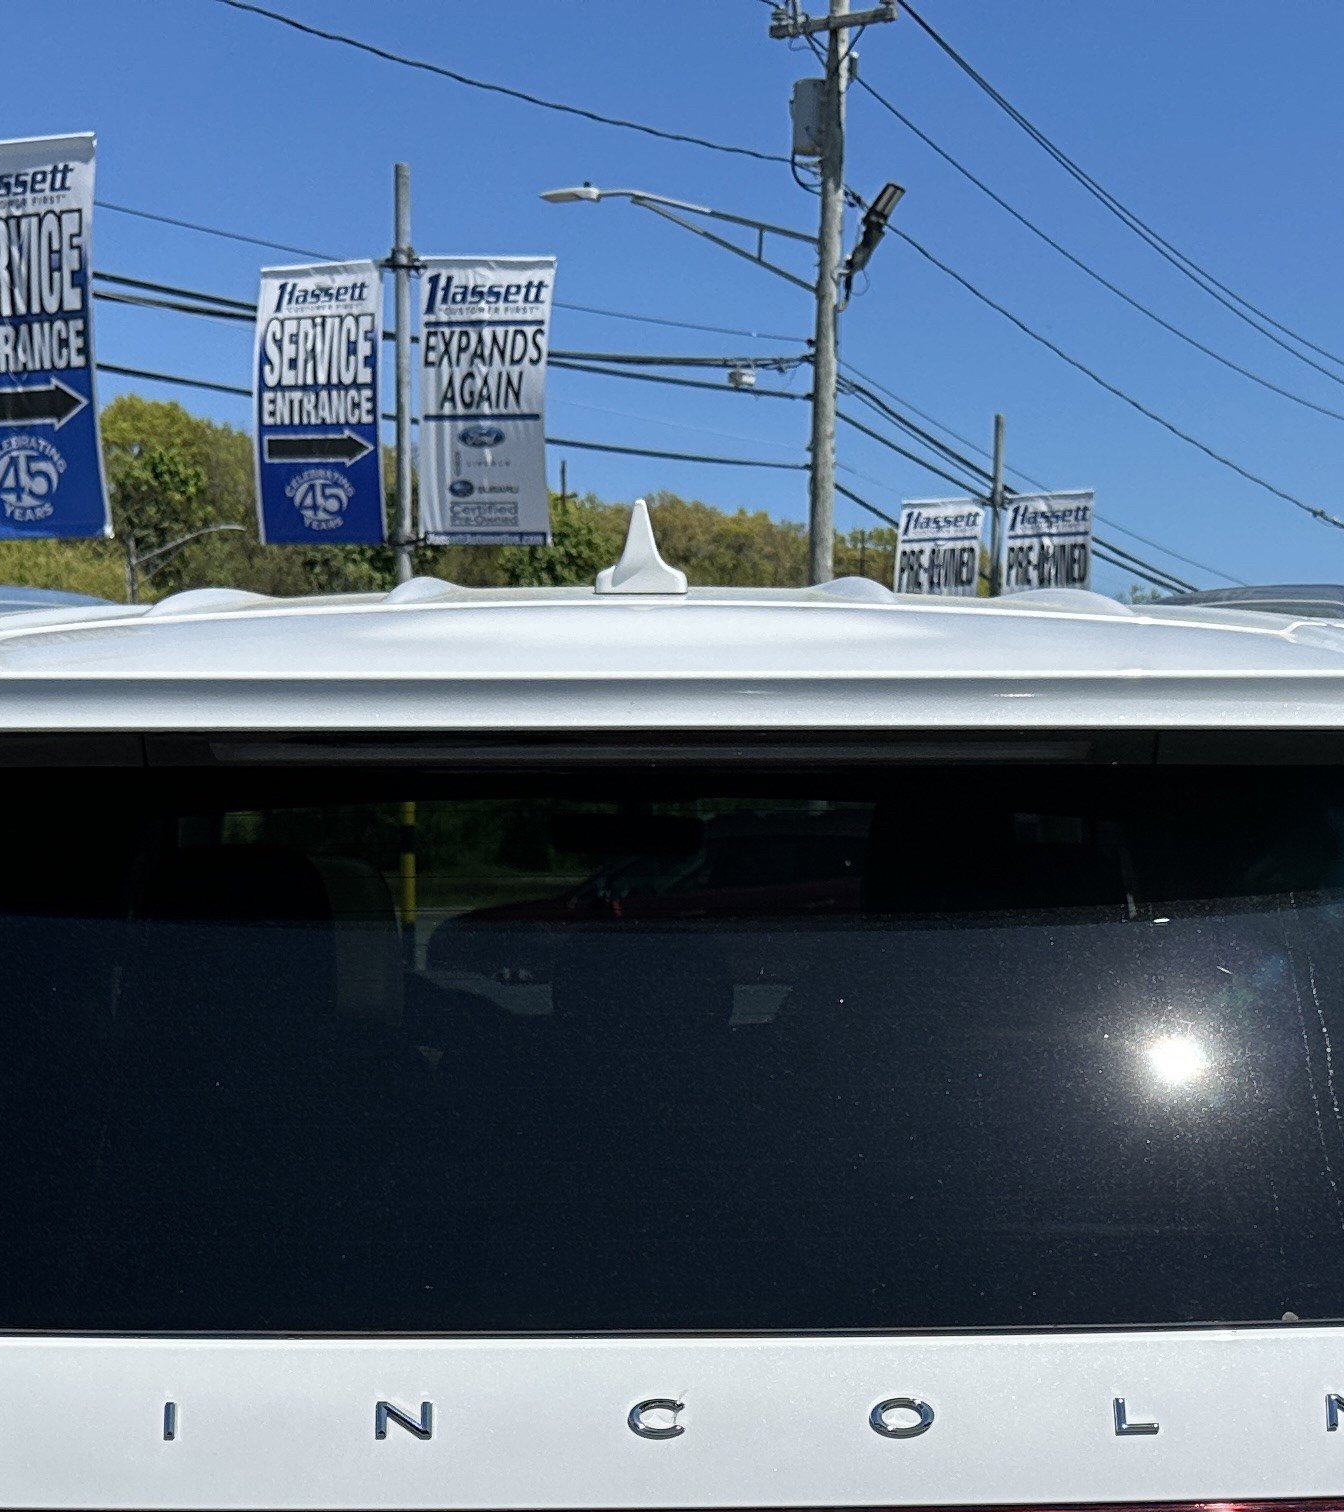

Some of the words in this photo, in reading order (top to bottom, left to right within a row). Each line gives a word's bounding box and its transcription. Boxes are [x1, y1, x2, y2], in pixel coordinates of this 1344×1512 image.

[263, 313, 375, 388] SERVICE
[423, 328, 545, 368] EXPANDS
[262, 388, 374, 426] ENTRANCE
[440, 371, 524, 411] AGAIN
[4, 502, 54, 521] YEARS
[299, 483, 344, 516] 45
